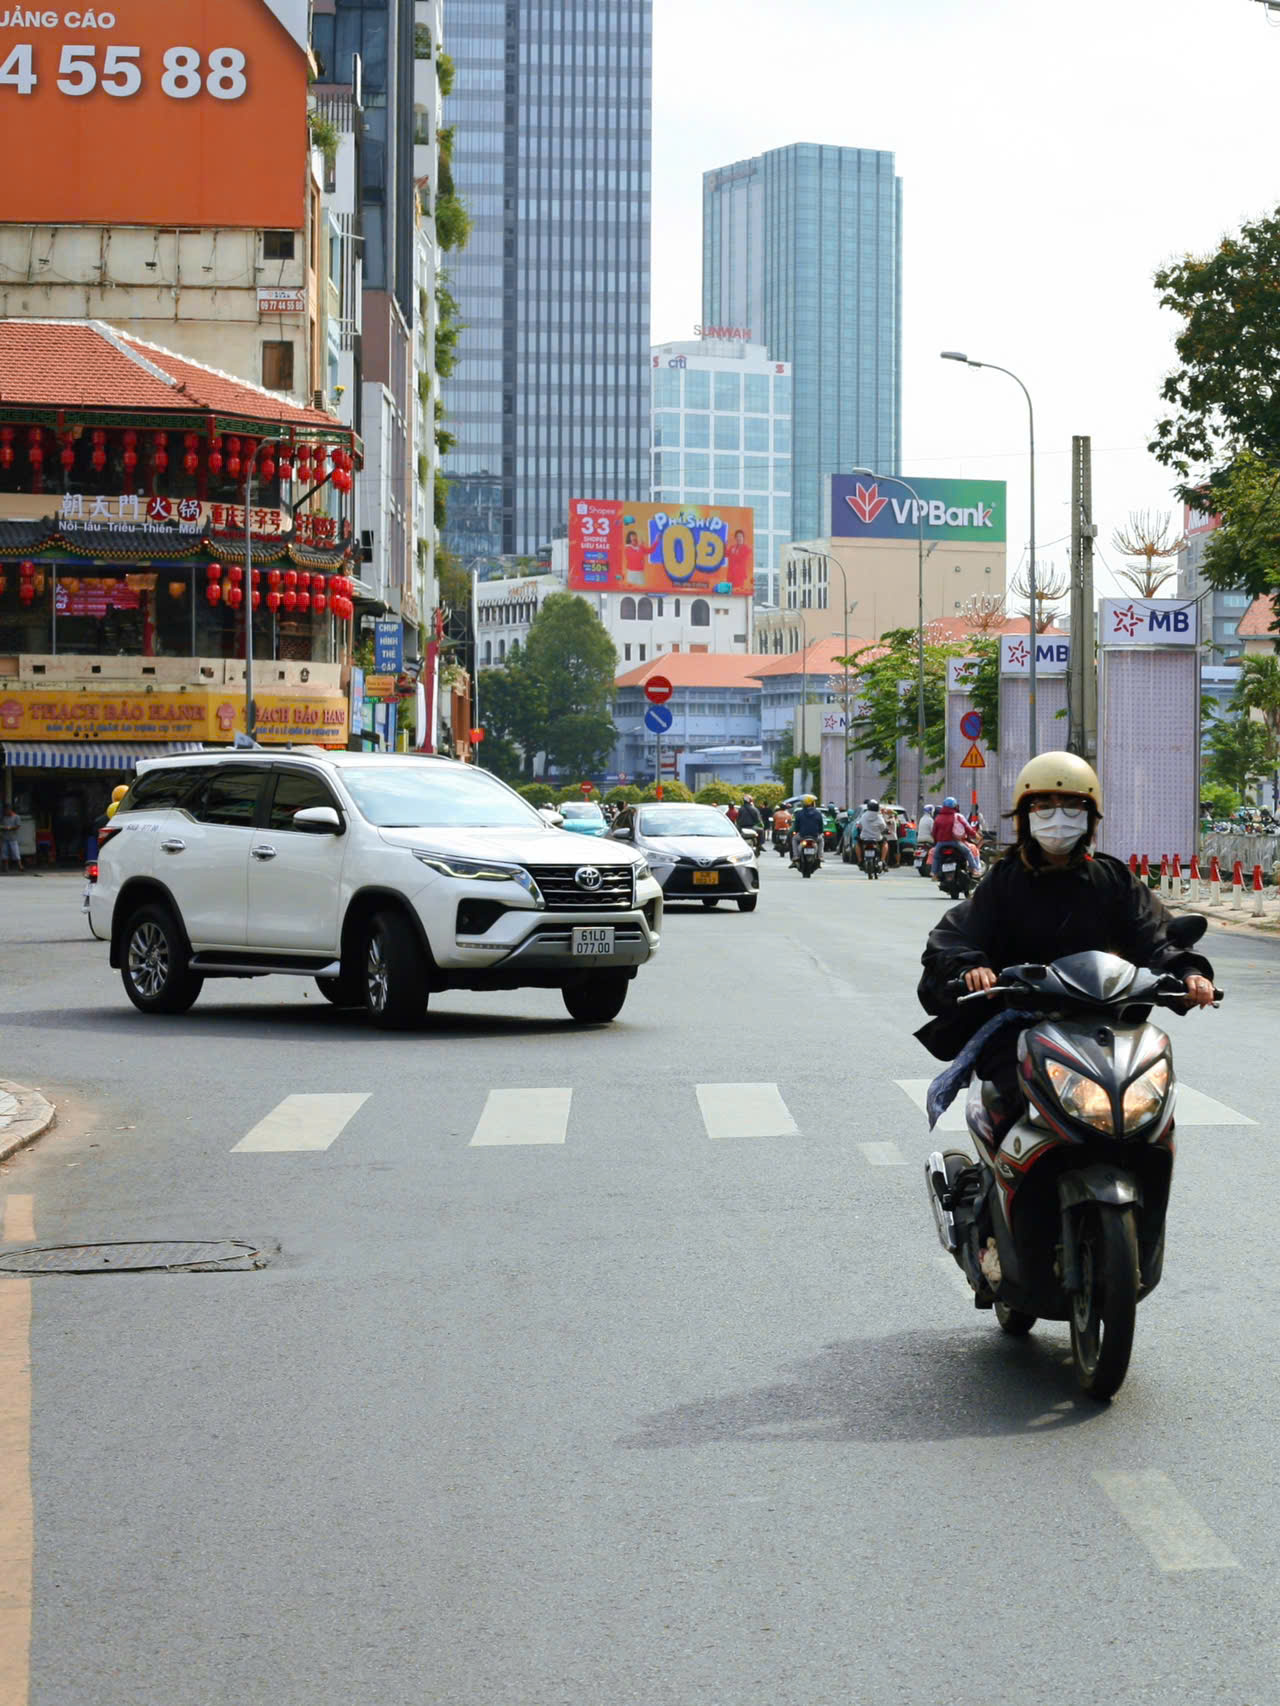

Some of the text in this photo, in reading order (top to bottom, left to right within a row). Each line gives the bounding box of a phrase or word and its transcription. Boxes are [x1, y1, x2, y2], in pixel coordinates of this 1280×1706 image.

[63, 8, 116, 29] CÁO
[56, 45, 142, 97] 55
[161, 47, 247, 100] 88
[891, 497, 993, 528] VPBank
[1148, 611, 1190, 633] MB
[1035, 644, 1070, 663] MB
[582, 930, 606, 941] 61LD
[577, 942, 610, 954] 077.00
